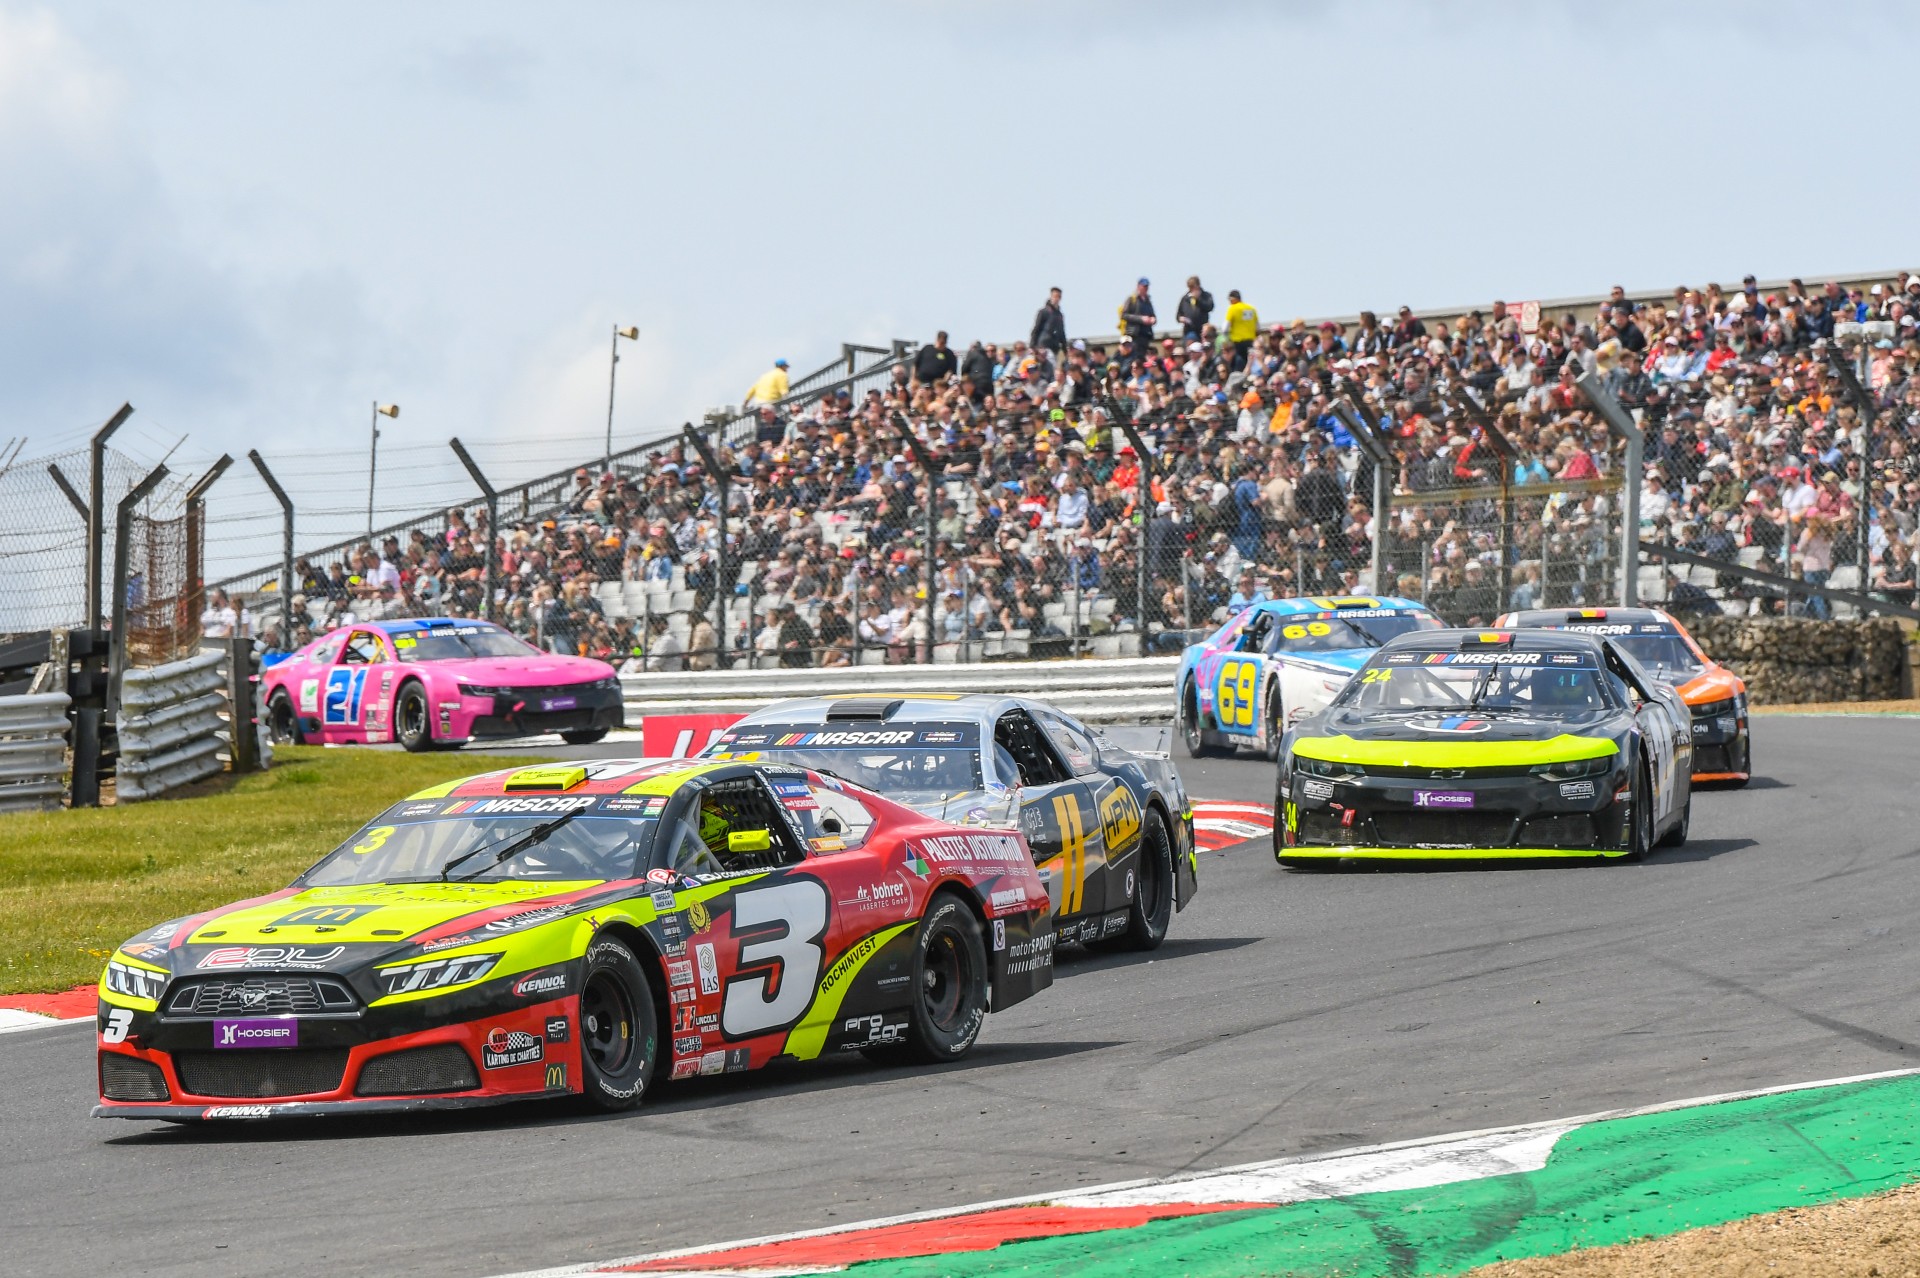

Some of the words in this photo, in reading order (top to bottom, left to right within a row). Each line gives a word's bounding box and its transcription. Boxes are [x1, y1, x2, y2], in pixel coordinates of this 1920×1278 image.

[1337, 609, 1396, 618] NASCAR
[1282, 621, 1331, 640] 69
[1563, 624, 1632, 635] NASCAR
[1451, 653, 1541, 664] NASCAR
[1361, 667, 1393, 684] 24
[324, 666, 369, 725] 21
[1218, 661, 1256, 727] 69
[808, 730, 914, 745] NASCAR
[475, 797, 596, 813] NASCAR
[1103, 792, 1137, 842] HPM
[353, 825, 395, 854] 3
[920, 836, 972, 862] PALETTES
[966, 835, 1025, 862] DISTRIBUTION
[1052, 793, 1084, 917] 11
[872, 881, 904, 899] bohrer
[860, 900, 890, 911] LASERTEC
[927, 903, 956, 935] HOOSIER
[594, 942, 631, 962] HOOSIER
[724, 878, 830, 1036] 3
[821, 937, 877, 994] ROCHINVEST
[517, 975, 566, 993] KENNOL
[702, 976, 719, 992] IAS
[103, 1009, 134, 1043] 3
[696, 1014, 717, 1026] LINCOLN
[845, 1014, 883, 1031] pro
[238, 1028, 290, 1039] HOOSIER
[950, 1024, 978, 1053] HOOSIER
[676, 1036, 701, 1050] QUARTER
[487, 1052, 509, 1067] KARTING
[510, 1053, 516, 1062] DE
[517, 1045, 540, 1062] CHARTRES
[599, 1078, 637, 1099] HOOSIER
[207, 1106, 273, 1117] KENNOL
